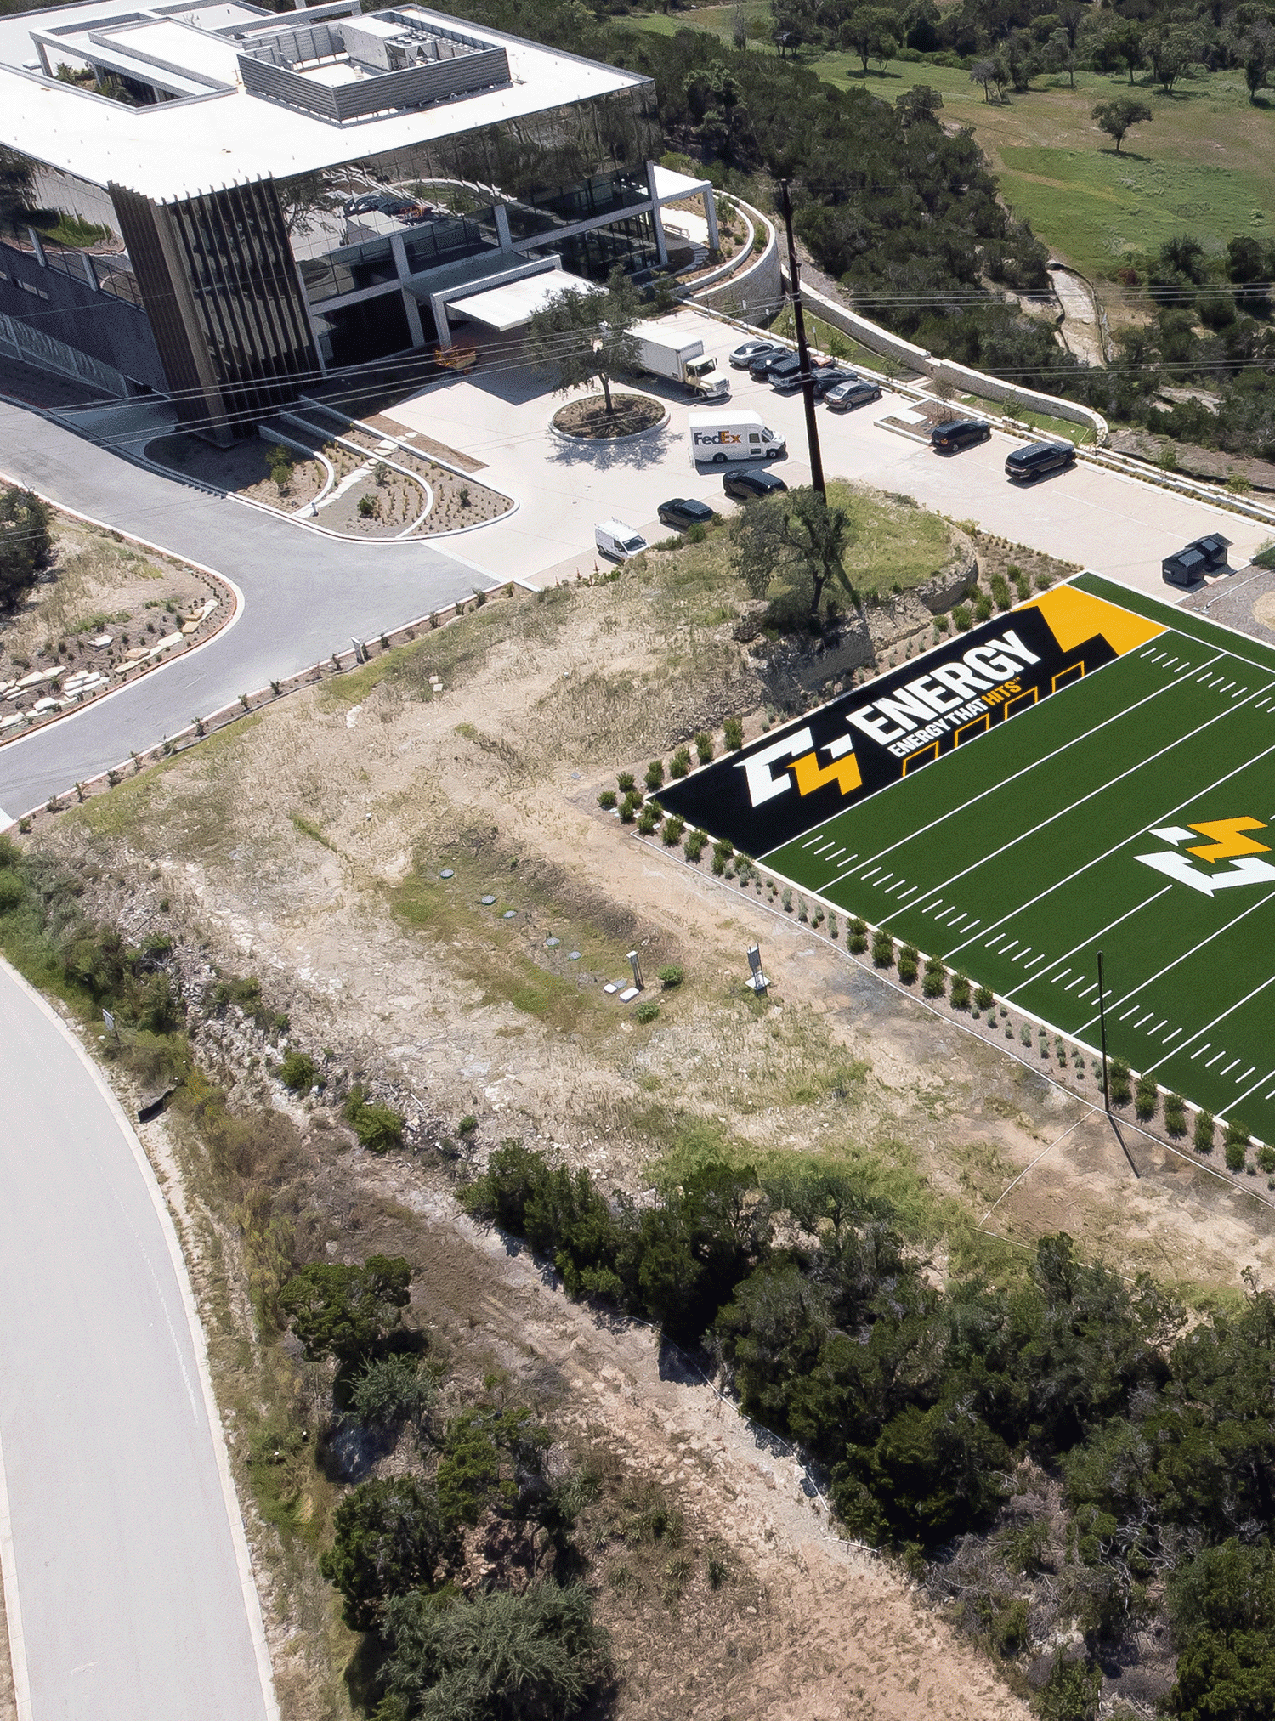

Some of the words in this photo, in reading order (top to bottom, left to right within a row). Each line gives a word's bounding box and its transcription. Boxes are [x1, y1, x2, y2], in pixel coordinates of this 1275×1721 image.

[694, 431, 742, 445] FedEx
[846, 630, 1042, 746] ENERGY
[886, 718, 951, 757] ENERGY
[943, 698, 989, 725] THAT
